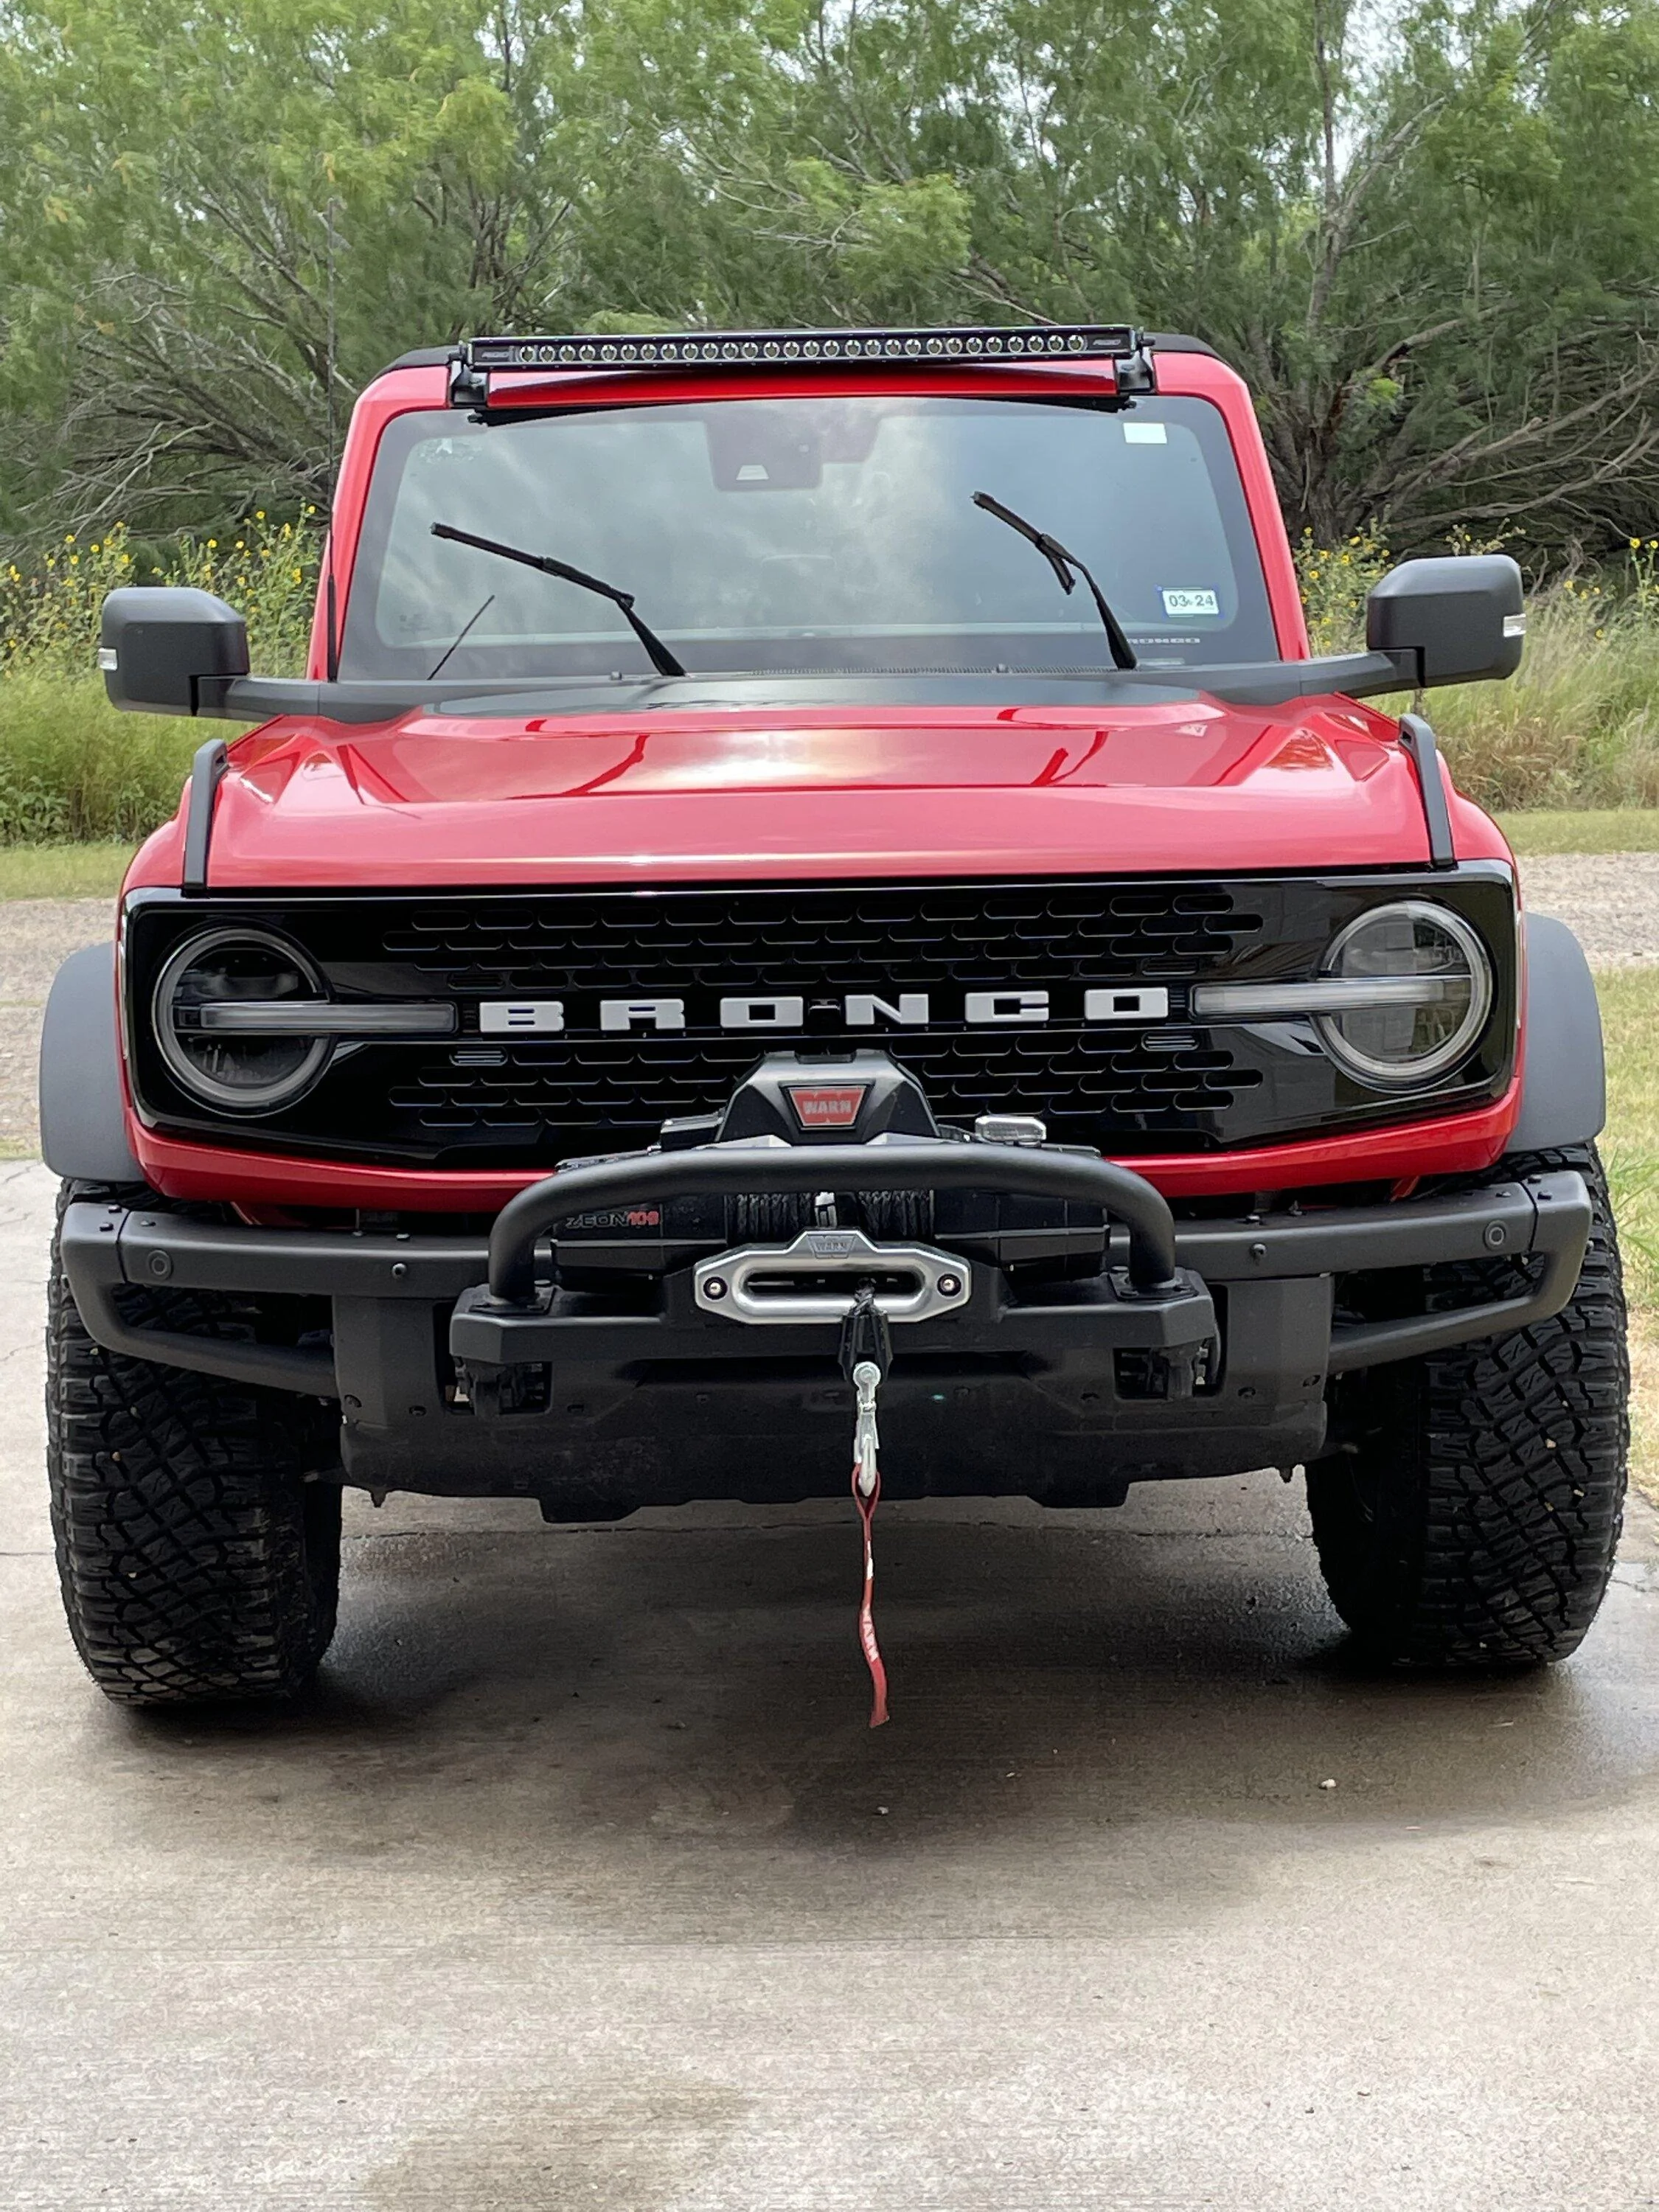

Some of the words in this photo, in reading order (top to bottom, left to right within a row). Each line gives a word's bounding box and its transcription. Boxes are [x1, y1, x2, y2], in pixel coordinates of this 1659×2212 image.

[479, 987, 1168, 1032] BRONCO
[802, 1100, 852, 1114] WARN
[813, 1241, 850, 1252] WARN
